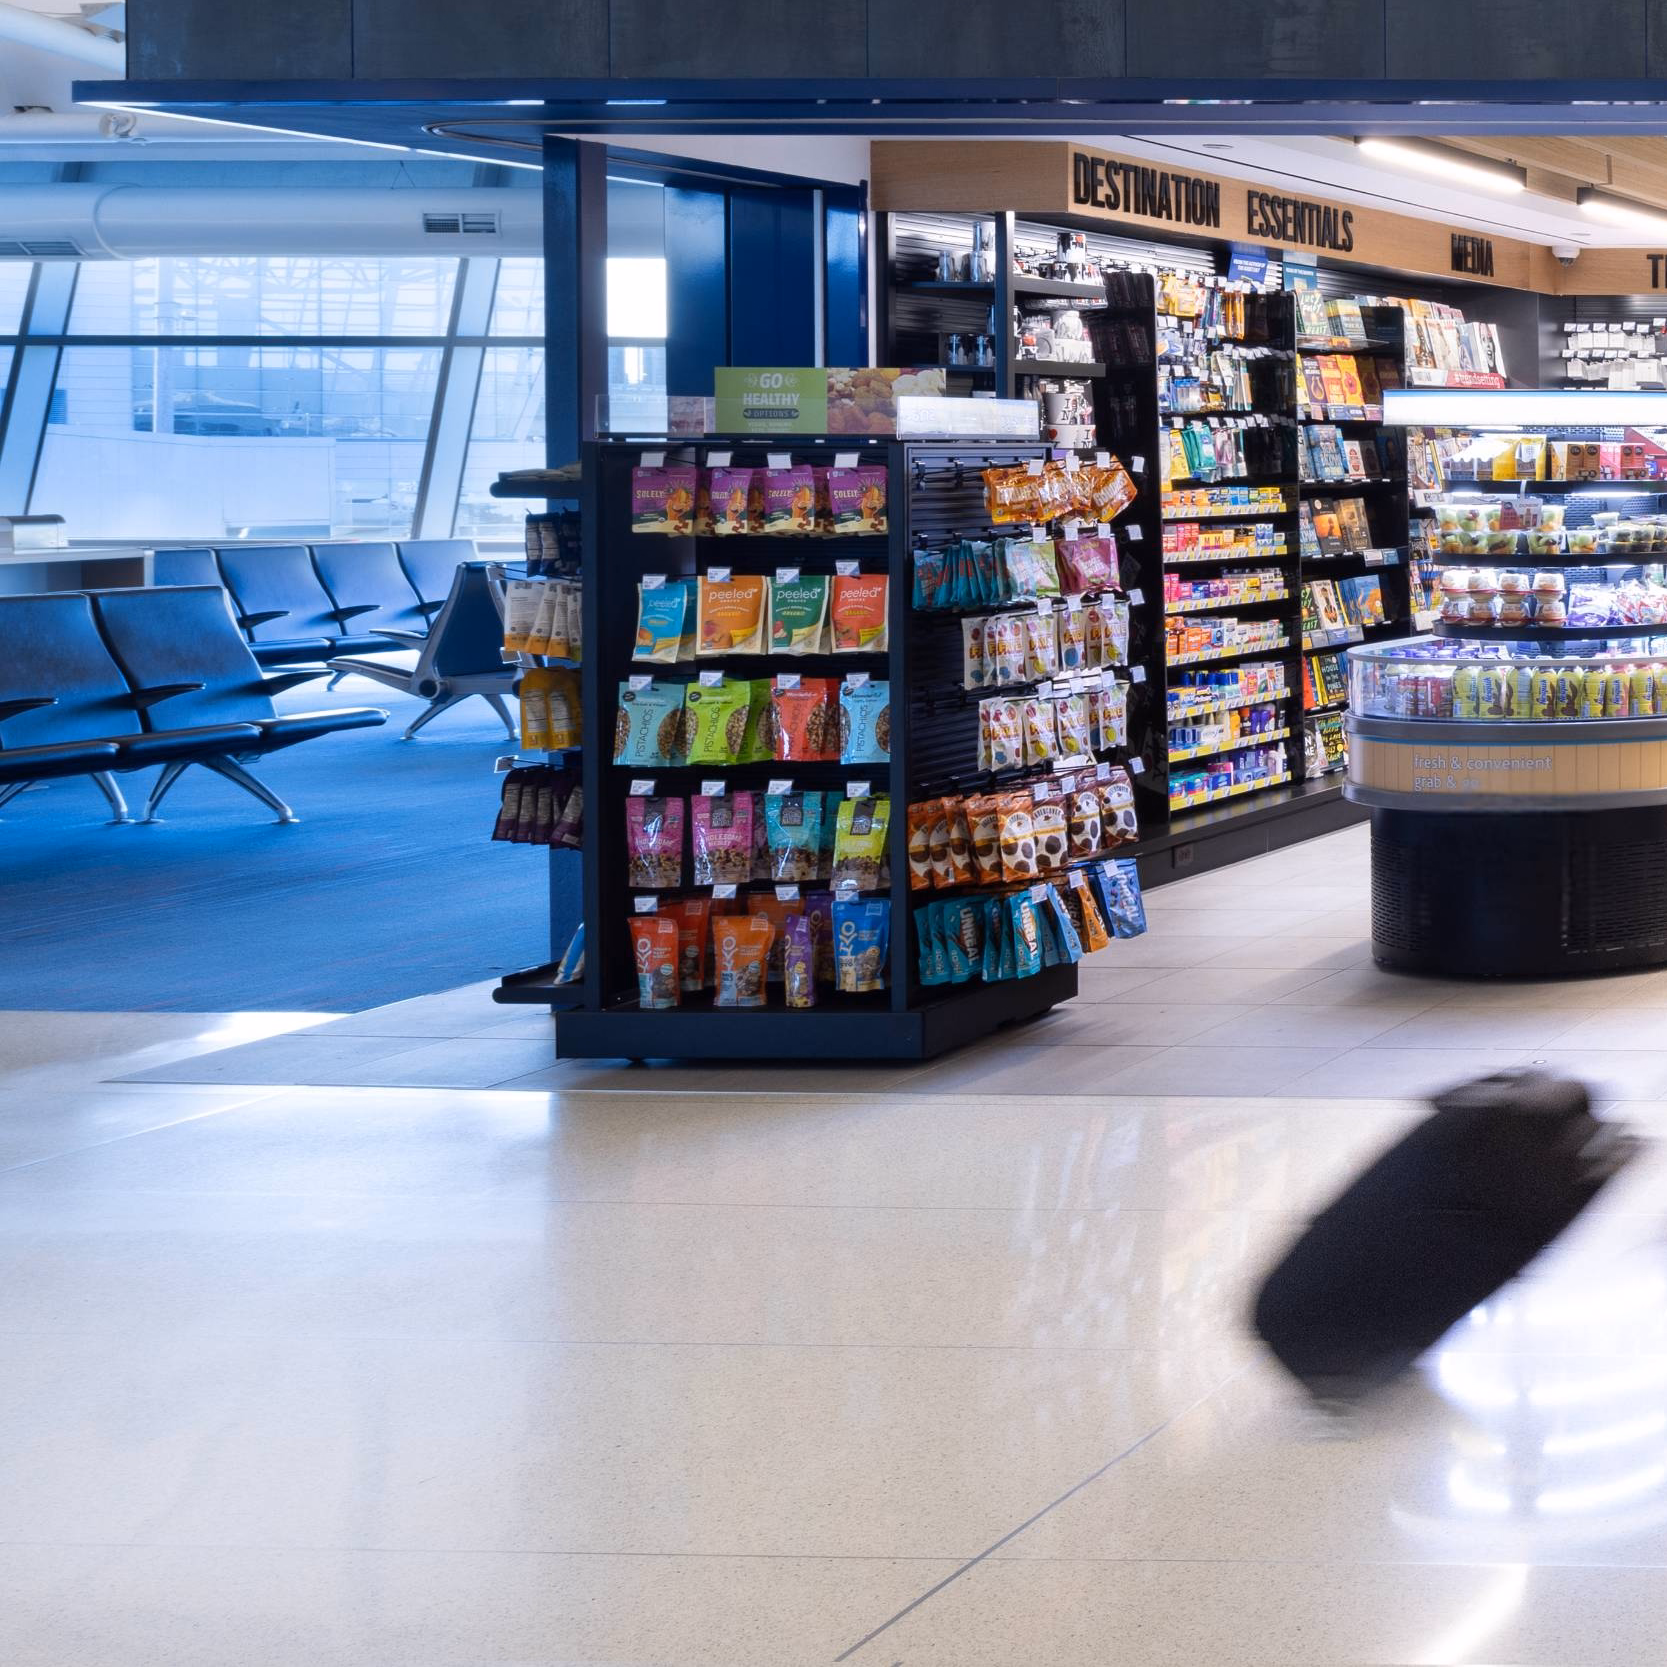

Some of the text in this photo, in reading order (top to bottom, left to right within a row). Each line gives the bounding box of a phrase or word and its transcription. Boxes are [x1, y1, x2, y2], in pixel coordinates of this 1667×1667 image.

[1073, 152, 1353, 252] DESTINATION ESSENTIALS
[1451, 233, 1494, 277] MEDIA
[761, 373, 783, 388] GO
[743, 393, 800, 406] HEALTHY
[833, 489, 858, 499] SOLELY
[708, 588, 753, 604] peeled
[776, 588, 817, 603] peeled
[839, 588, 879, 603] peeled
[635, 708, 654, 757] PISTACHIOS
[703, 707, 721, 753] PISTACHIOS
[856, 704, 869, 752] PISTACHIOS
[1414, 755, 1552, 770] fresh & convenient
[1415, 775, 1441, 792] grab
[1446, 775, 1456, 789] &
[959, 906, 980, 966] UNREAL
[1020, 901, 1037, 960] UNREAL
